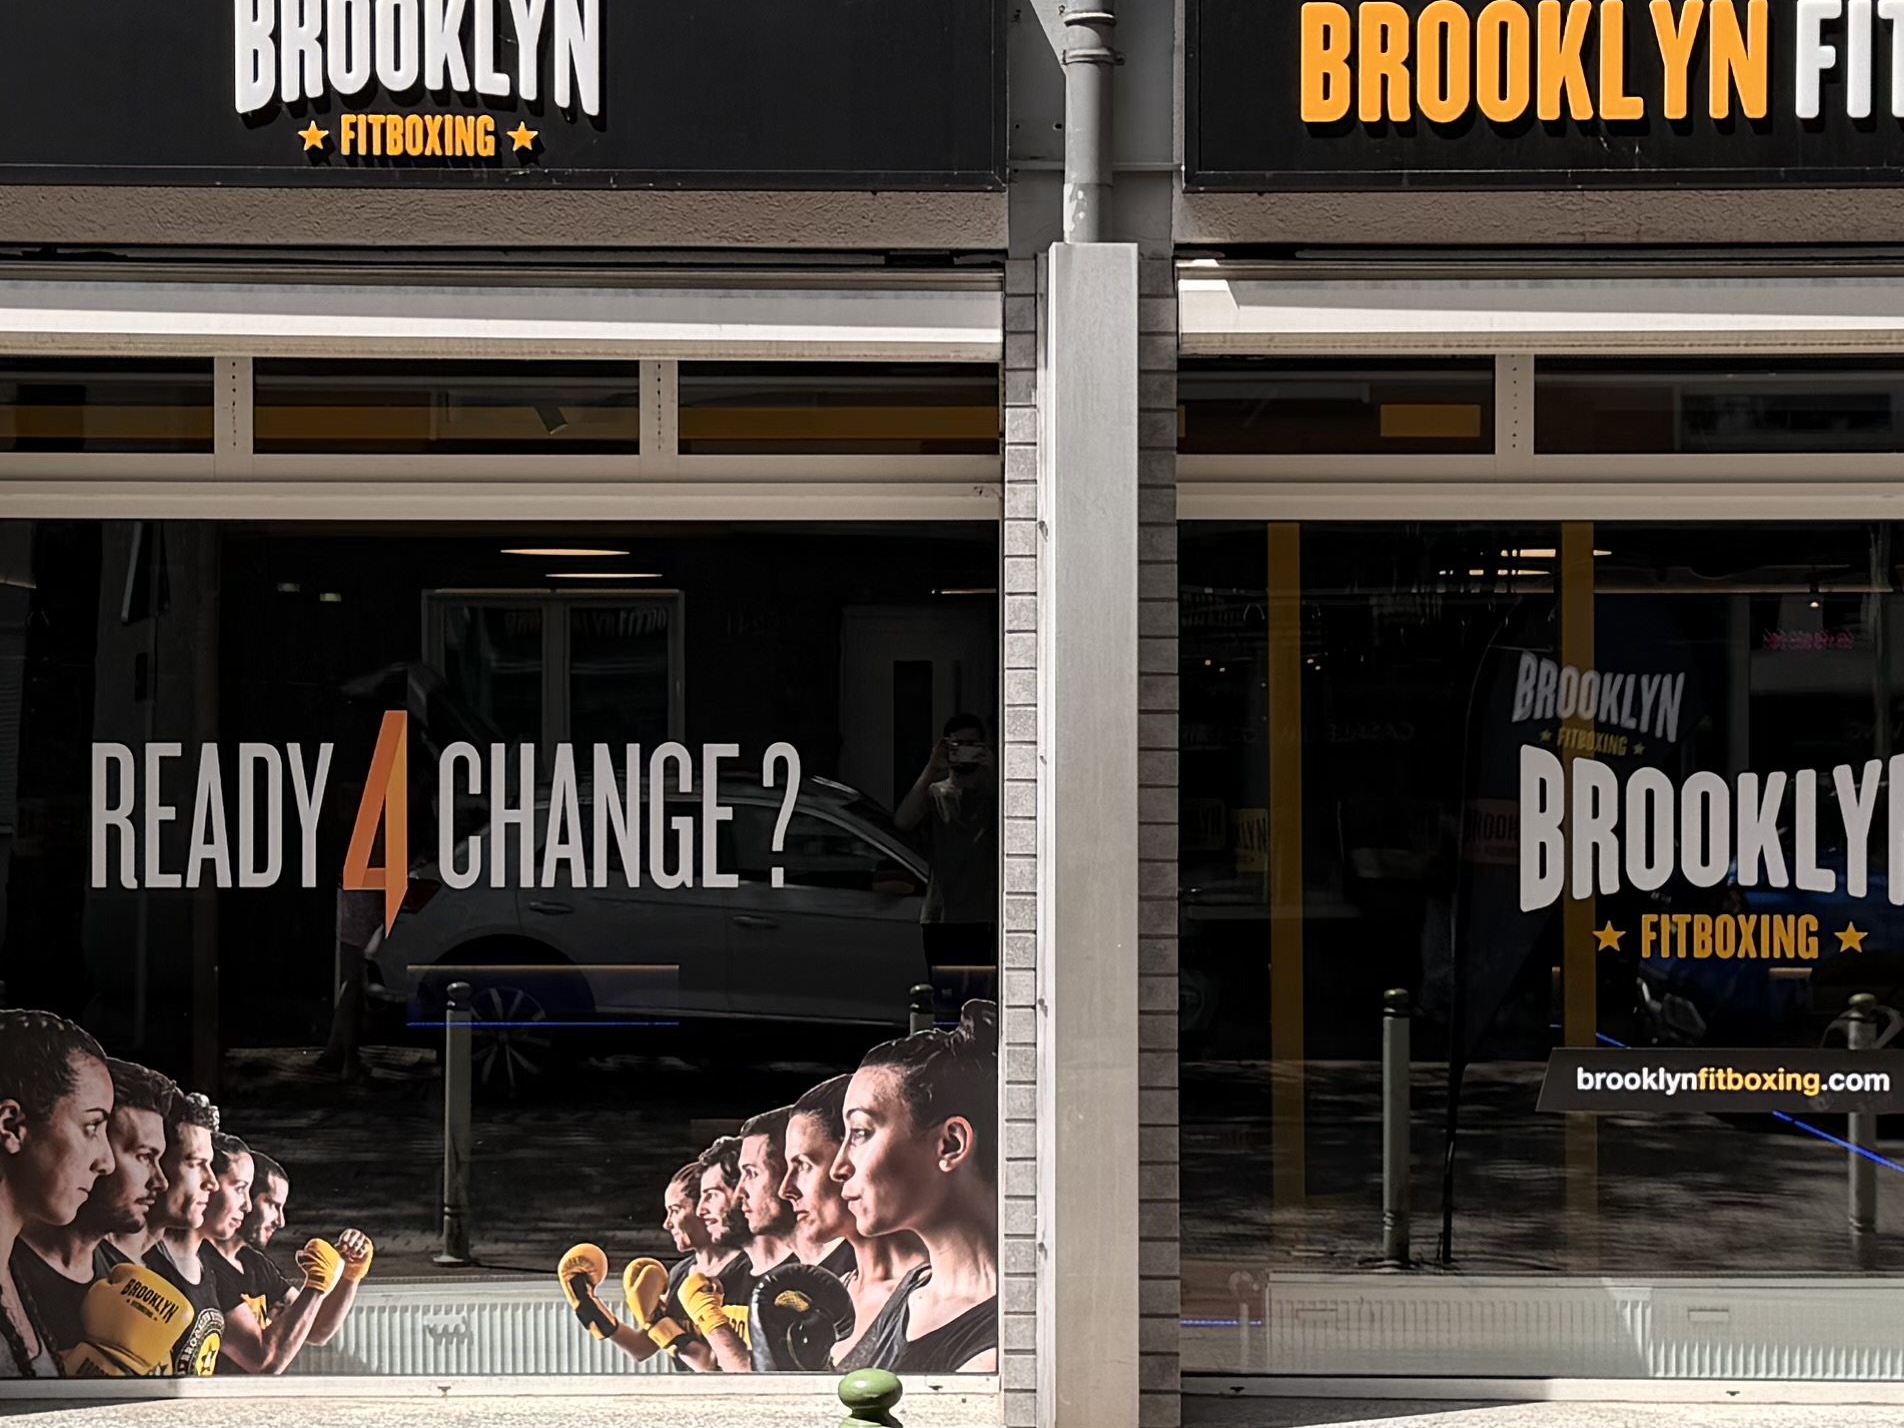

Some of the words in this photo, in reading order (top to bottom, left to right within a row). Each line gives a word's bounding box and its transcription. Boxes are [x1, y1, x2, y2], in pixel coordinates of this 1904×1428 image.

[340, 113, 496, 157] FITBOXING
[1511, 651, 1686, 743] BROOKLYN
[91, 741, 335, 889] READY
[343, 709, 408, 938] 4
[439, 741, 740, 889] CHANGE
[1641, 913, 1820, 960] FITBOXING
[1576, 1065, 1891, 1098] brooklynfitboxing.com
[120, 1278, 179, 1324] BROOKLYN
